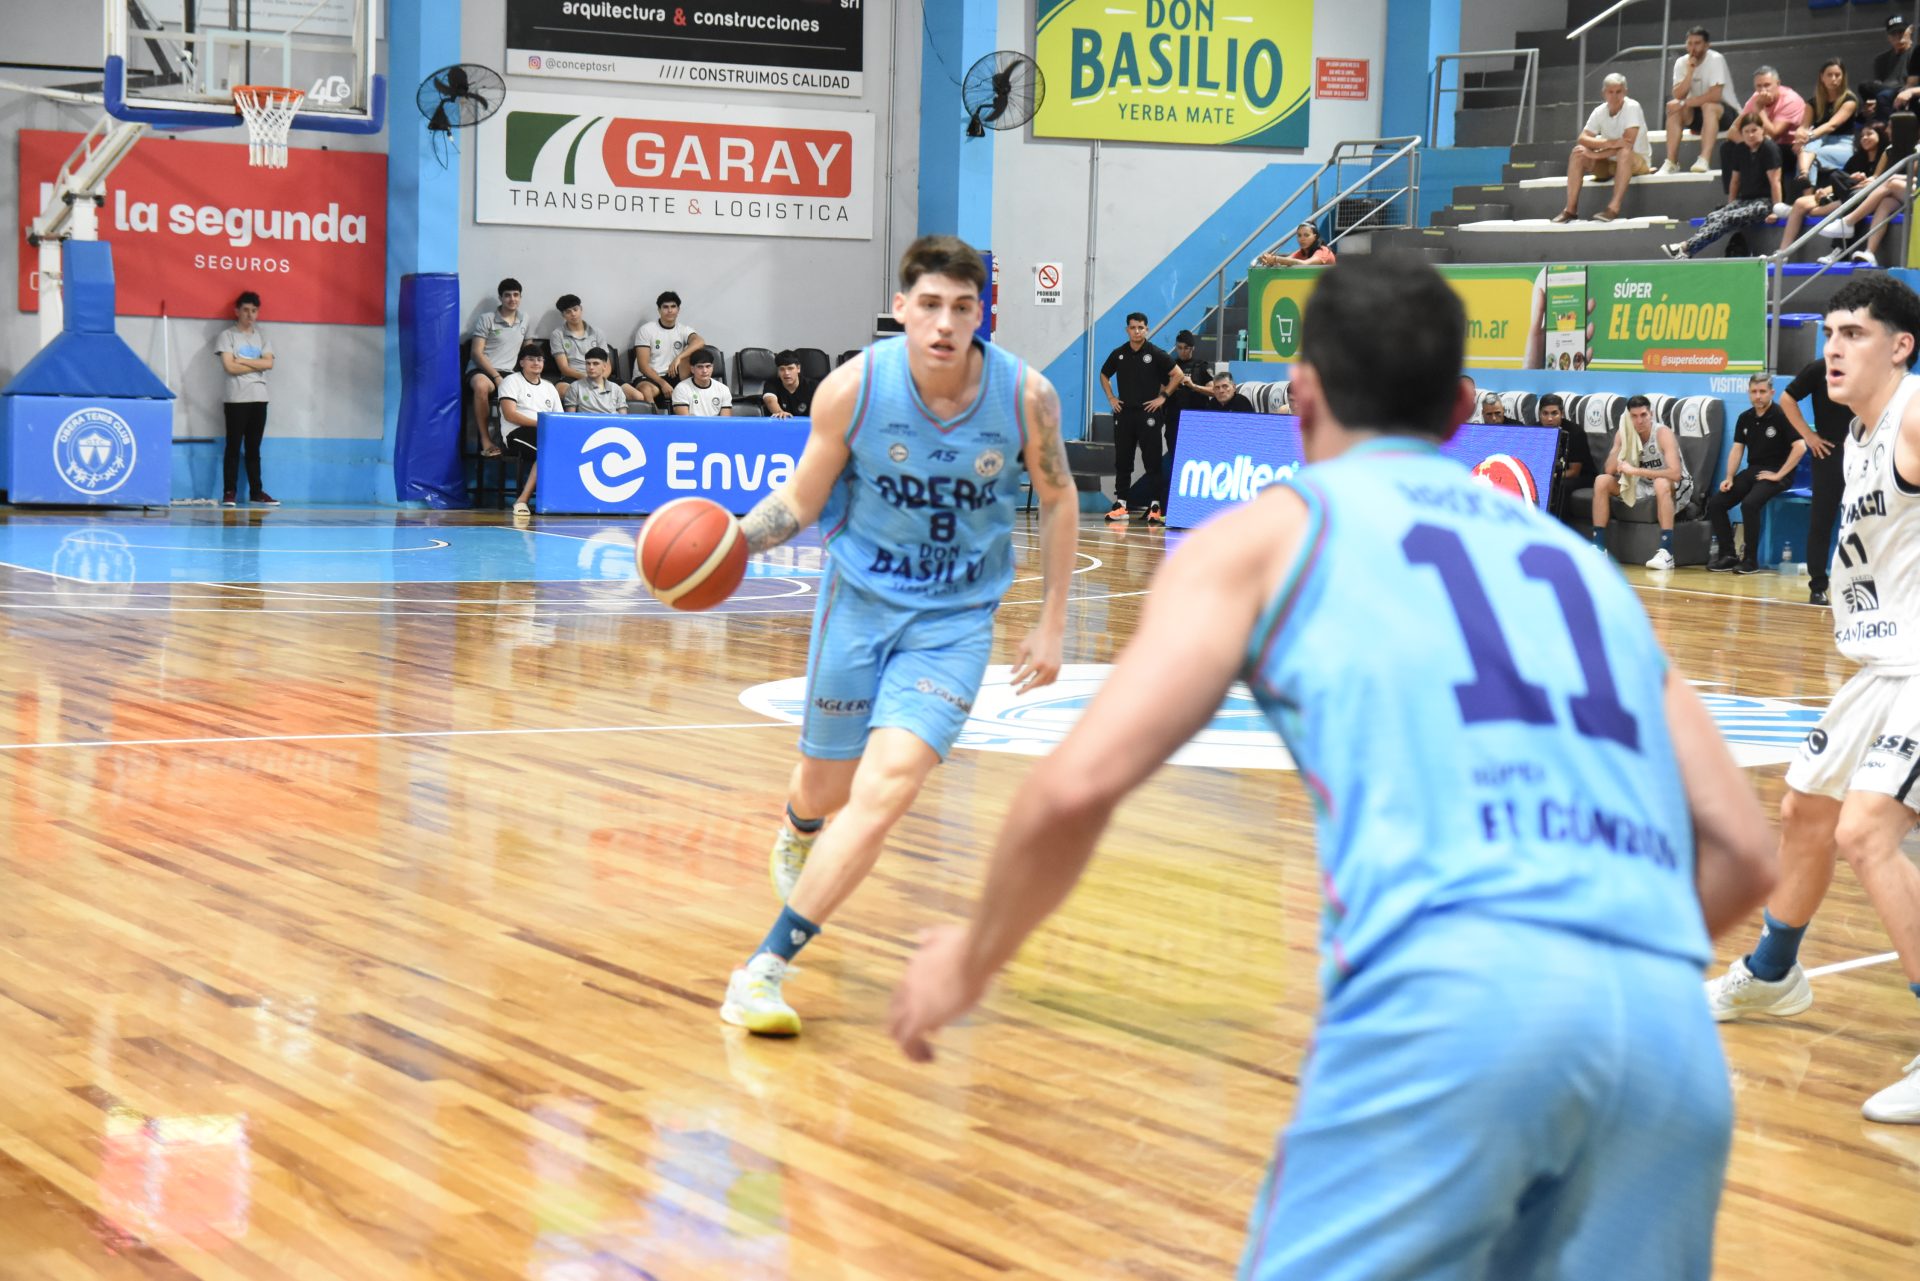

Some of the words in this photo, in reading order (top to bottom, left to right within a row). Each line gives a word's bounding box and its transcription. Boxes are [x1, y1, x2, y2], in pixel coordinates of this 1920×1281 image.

[562, 1, 666, 22] arquitectura
[673, 7, 687, 27] &
[693, 11, 820, 33] construcciones
[1146, 0, 1214, 32] DON
[545, 57, 616, 73] @conceptosrl
[689, 66, 789, 87] CONSTRUIMOS
[792, 72, 850, 90] CALIDAD
[1070, 27, 1283, 109] BASILIO
[1118, 103, 1178, 123] YERBA
[1186, 106, 1235, 125] MATE
[626, 132, 843, 187] GARAY
[114, 189, 159, 233] la
[168, 202, 367, 248] segunda
[509, 189, 676, 214] TRANSPORTE
[687, 198, 702, 216] &
[714, 199, 849, 222] LOGISTICA
[194, 253, 291, 273] SEGUROS
[1613, 277, 1653, 299] SÚPER
[1608, 303, 1631, 340] EL
[1636, 293, 1731, 341] CÓNDOR
[1660, 353, 1724, 367] @superelcondor
[930, 512, 956, 543] 8
[1402, 523, 1642, 752] 11
